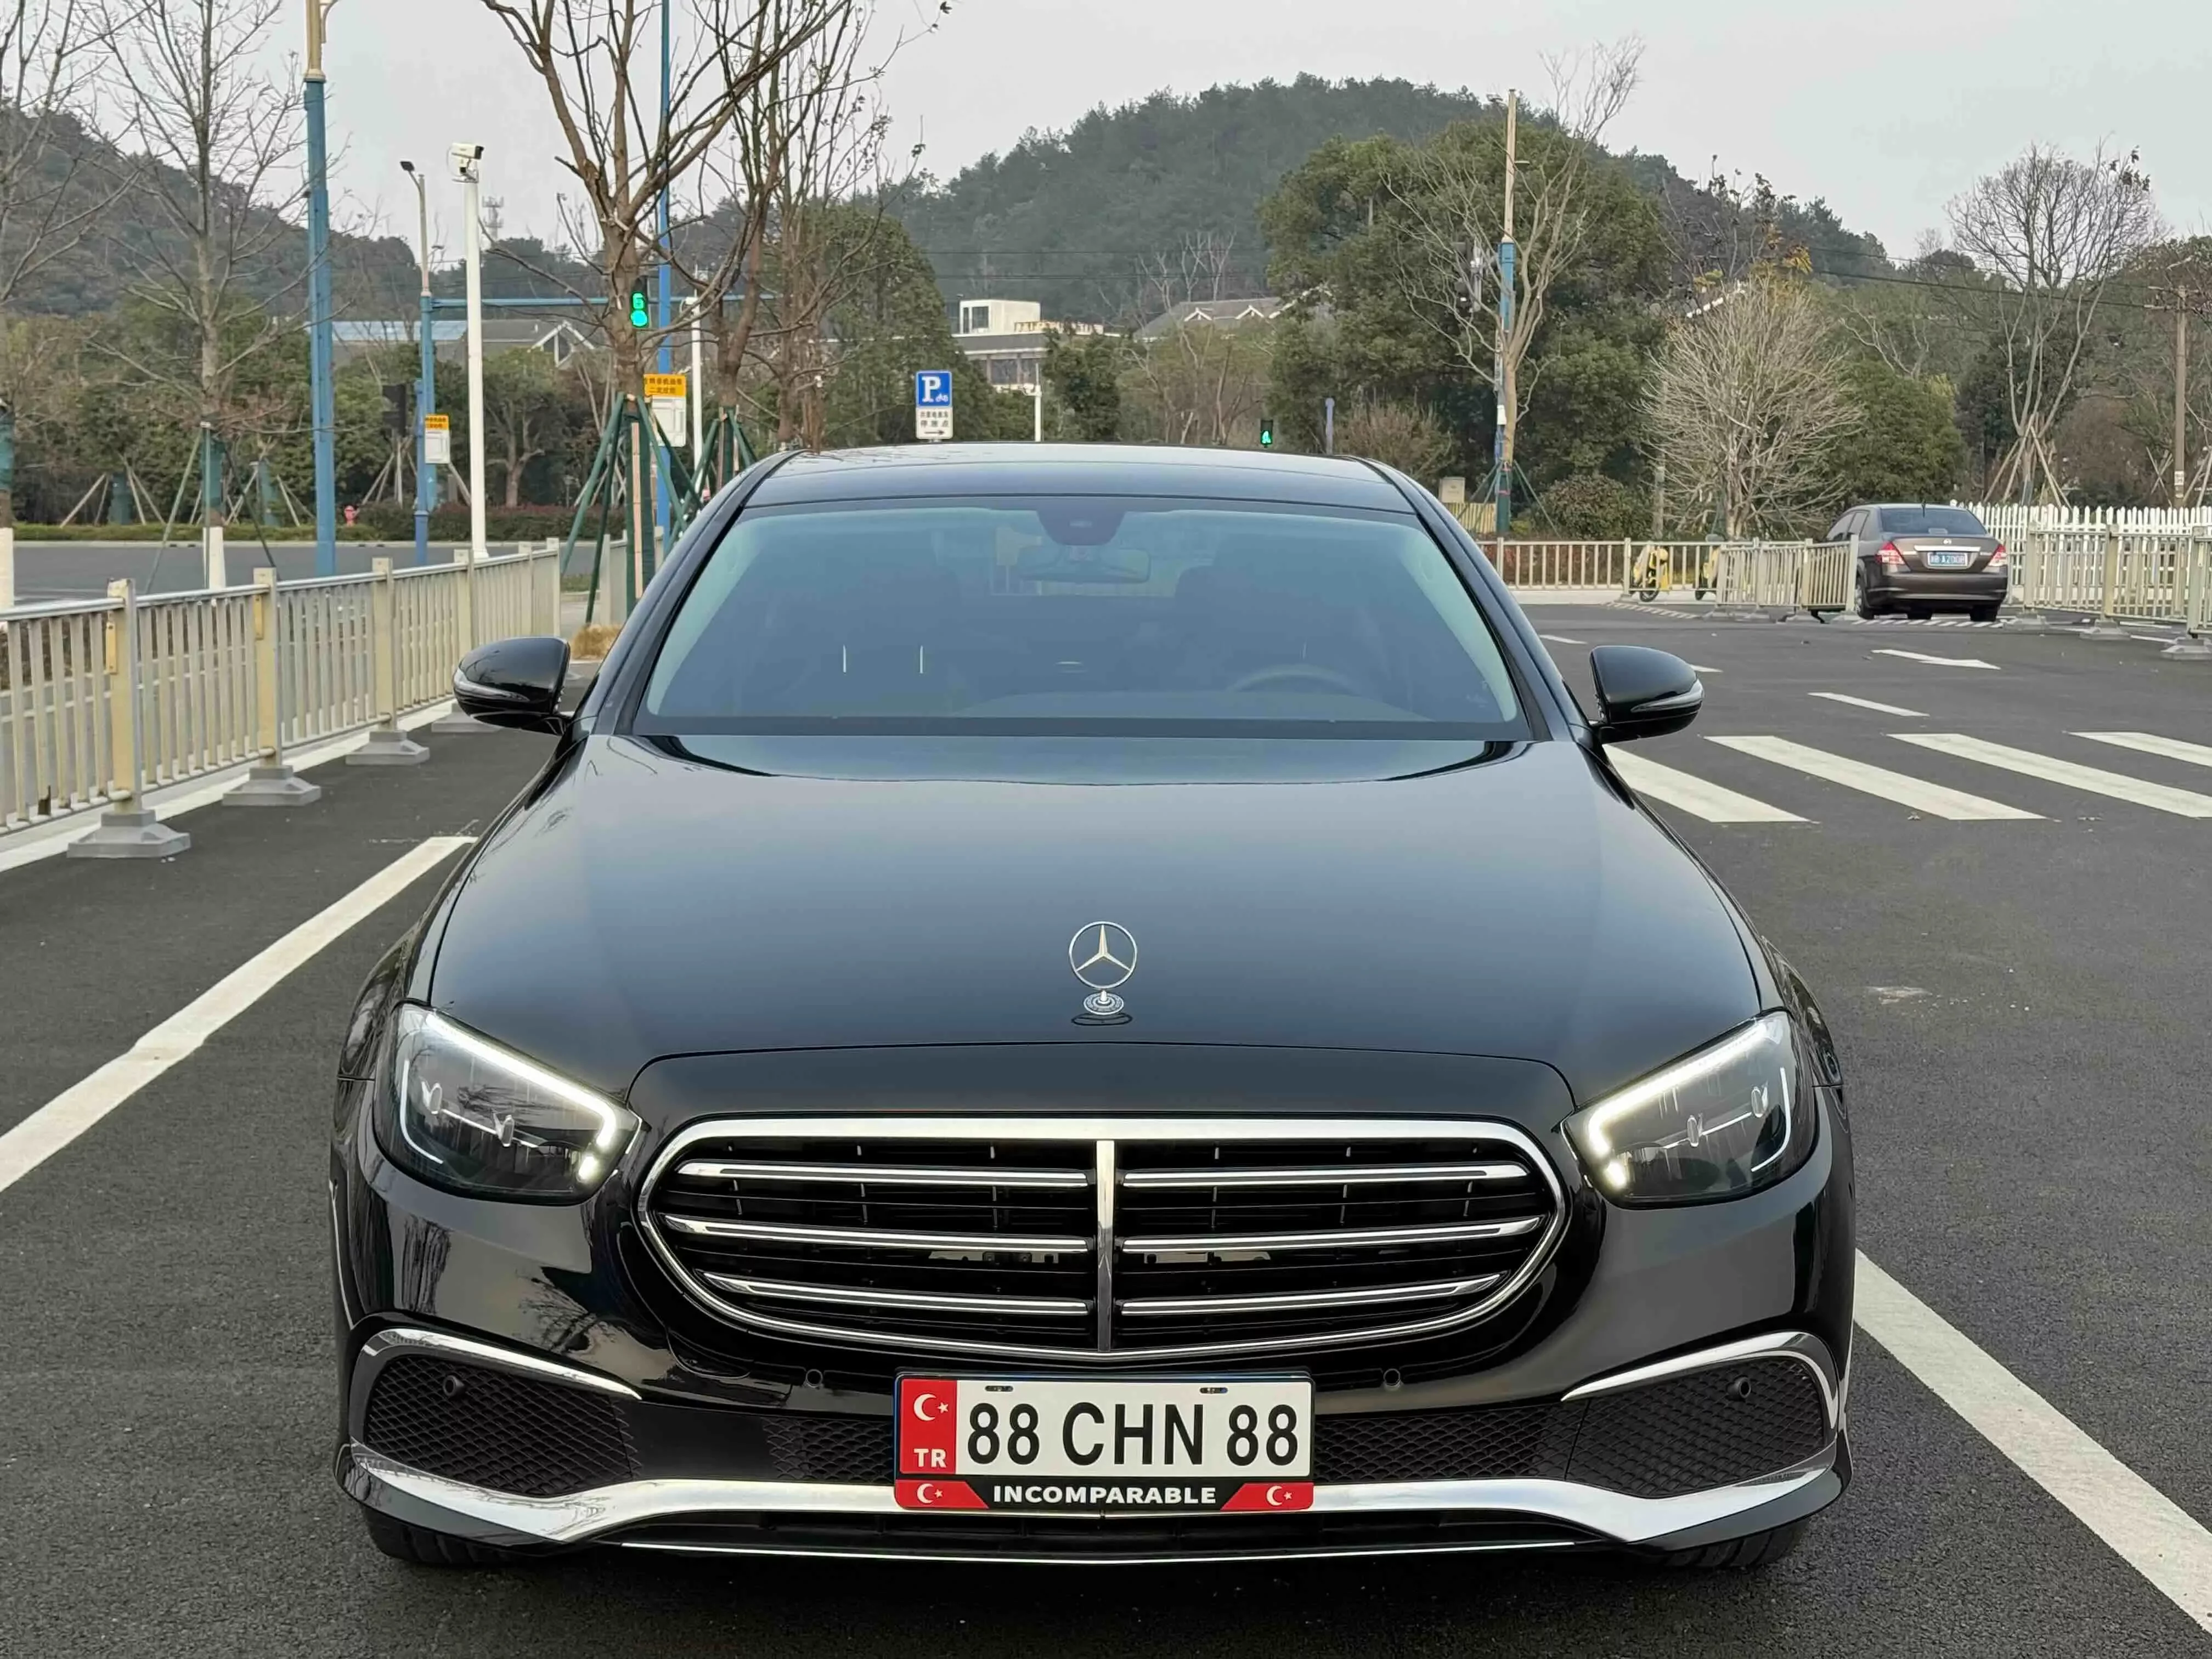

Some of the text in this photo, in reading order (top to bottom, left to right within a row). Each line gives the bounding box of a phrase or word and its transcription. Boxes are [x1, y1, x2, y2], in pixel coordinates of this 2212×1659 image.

[922, 376, 941, 402] P
[967, 1402, 1299, 1466] 88 CHN 88
[913, 1448, 947, 1468] TR
[993, 1485, 1216, 1504] INCOMPARABLE
